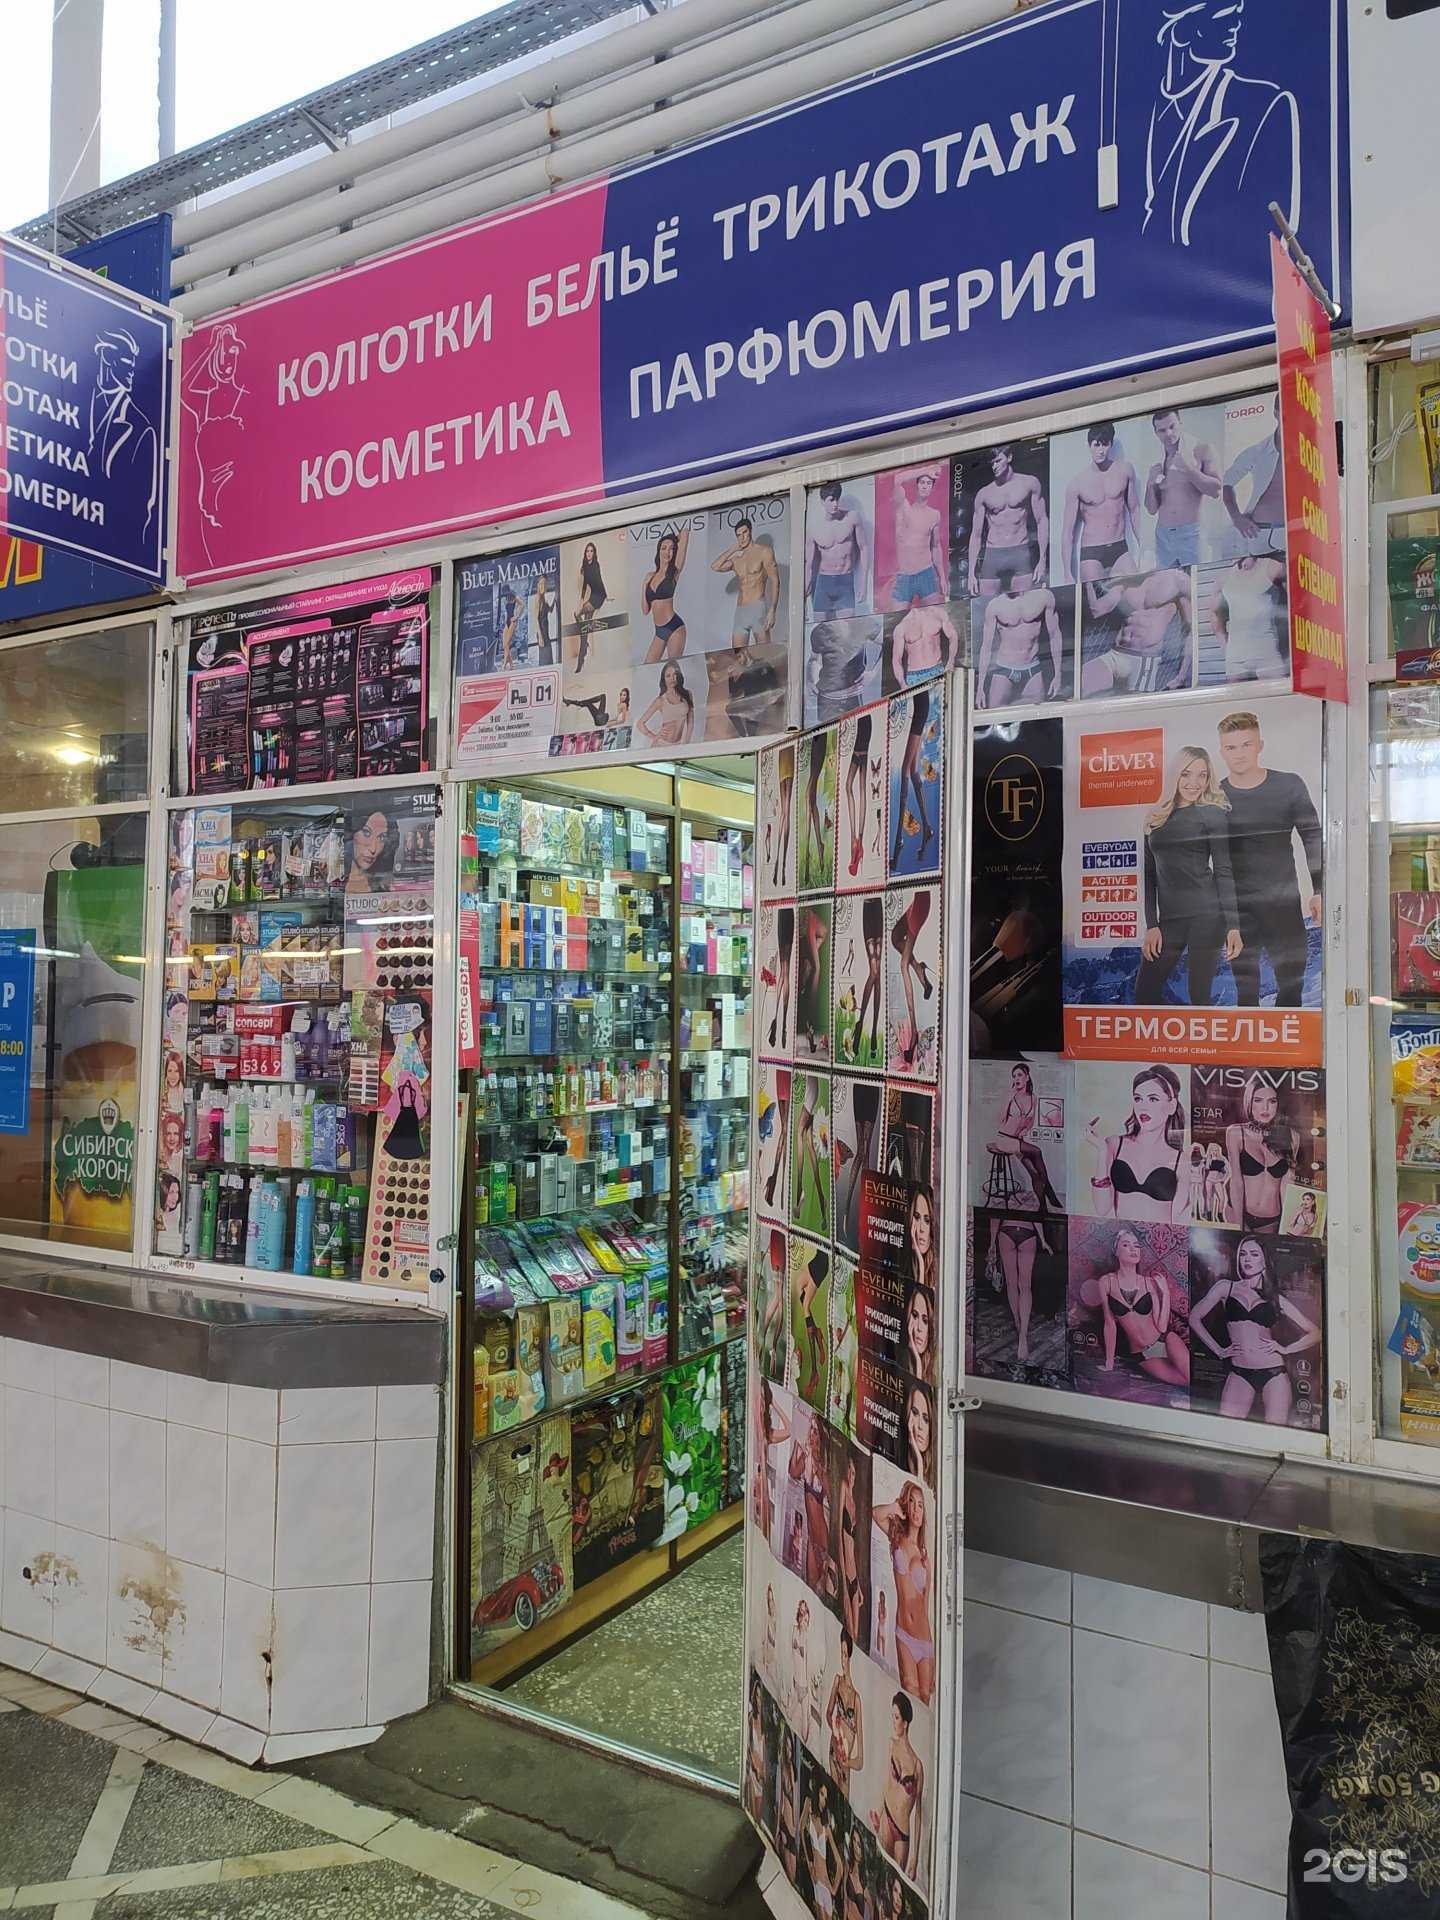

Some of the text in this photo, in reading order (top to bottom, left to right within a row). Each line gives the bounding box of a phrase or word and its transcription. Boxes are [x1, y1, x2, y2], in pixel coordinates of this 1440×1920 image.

[277, 94, 1078, 406] КОЛГОТКИ БЕЛЬЁ ТРИКОТАЖ
[0, 331, 78, 385] ОТКИ
[300, 238, 1096, 503] КОСМЕТИКА ПАРФЮМЕРИЯ
[0, 378, 81, 430] ОТАЖ
[1225, 404, 1265, 420] TORRO
[953, 463, 963, 498] TORRO
[713, 498, 785, 531] TORRO
[1303, 495, 1328, 545] СОКИ
[630, 515, 705, 542] VISAVIS
[498, 556, 557, 584] MADAME
[1298, 553, 1337, 607] СПЕЦИИ
[1294, 614, 1344, 671] ШОКОЛАД
[1088, 778, 1155, 790] thermal underwear
[992, 776, 1038, 823] TF
[1084, 842, 1135, 852] EVERYDAY
[1092, 876, 1129, 886] ACTIVE
[345, 898, 379, 910] STUDIO
[1084, 912, 1136, 921] OUTDOOR
[236, 1016, 274, 1030] concept
[1076, 1014, 1300, 1043] ТЕРМОБЕЛЬЁ
[351, 1041, 368, 1051] ХНА
[1190, 1047, 1217, 1055] СЕМЬИ
[1194, 1068, 1319, 1091] VISAVIS
[1194, 1107, 1223, 1119] STAR
[77, 1157, 132, 1183] КОРОН
[865, 1179, 908, 1201] EVELINE
[868, 1215, 904, 1234] ПРИХОДИТЕ
[874, 1232, 888, 1243] НАМ
[889, 1234, 903, 1248] ЕЩЁ
[862, 1269, 905, 1297] EVELINE
[864, 1305, 901, 1330] ПРИХОДИТЕ
[870, 1322, 883, 1336] НАМ
[884, 1329, 900, 1344] ЕЩЁ
[862, 1360, 904, 1393] EVELINE
[864, 1395, 900, 1425] ПРИХОДИТЕ
[869, 1415, 882, 1429] НАМ
[883, 1422, 898, 1439] ЕЩЁ
